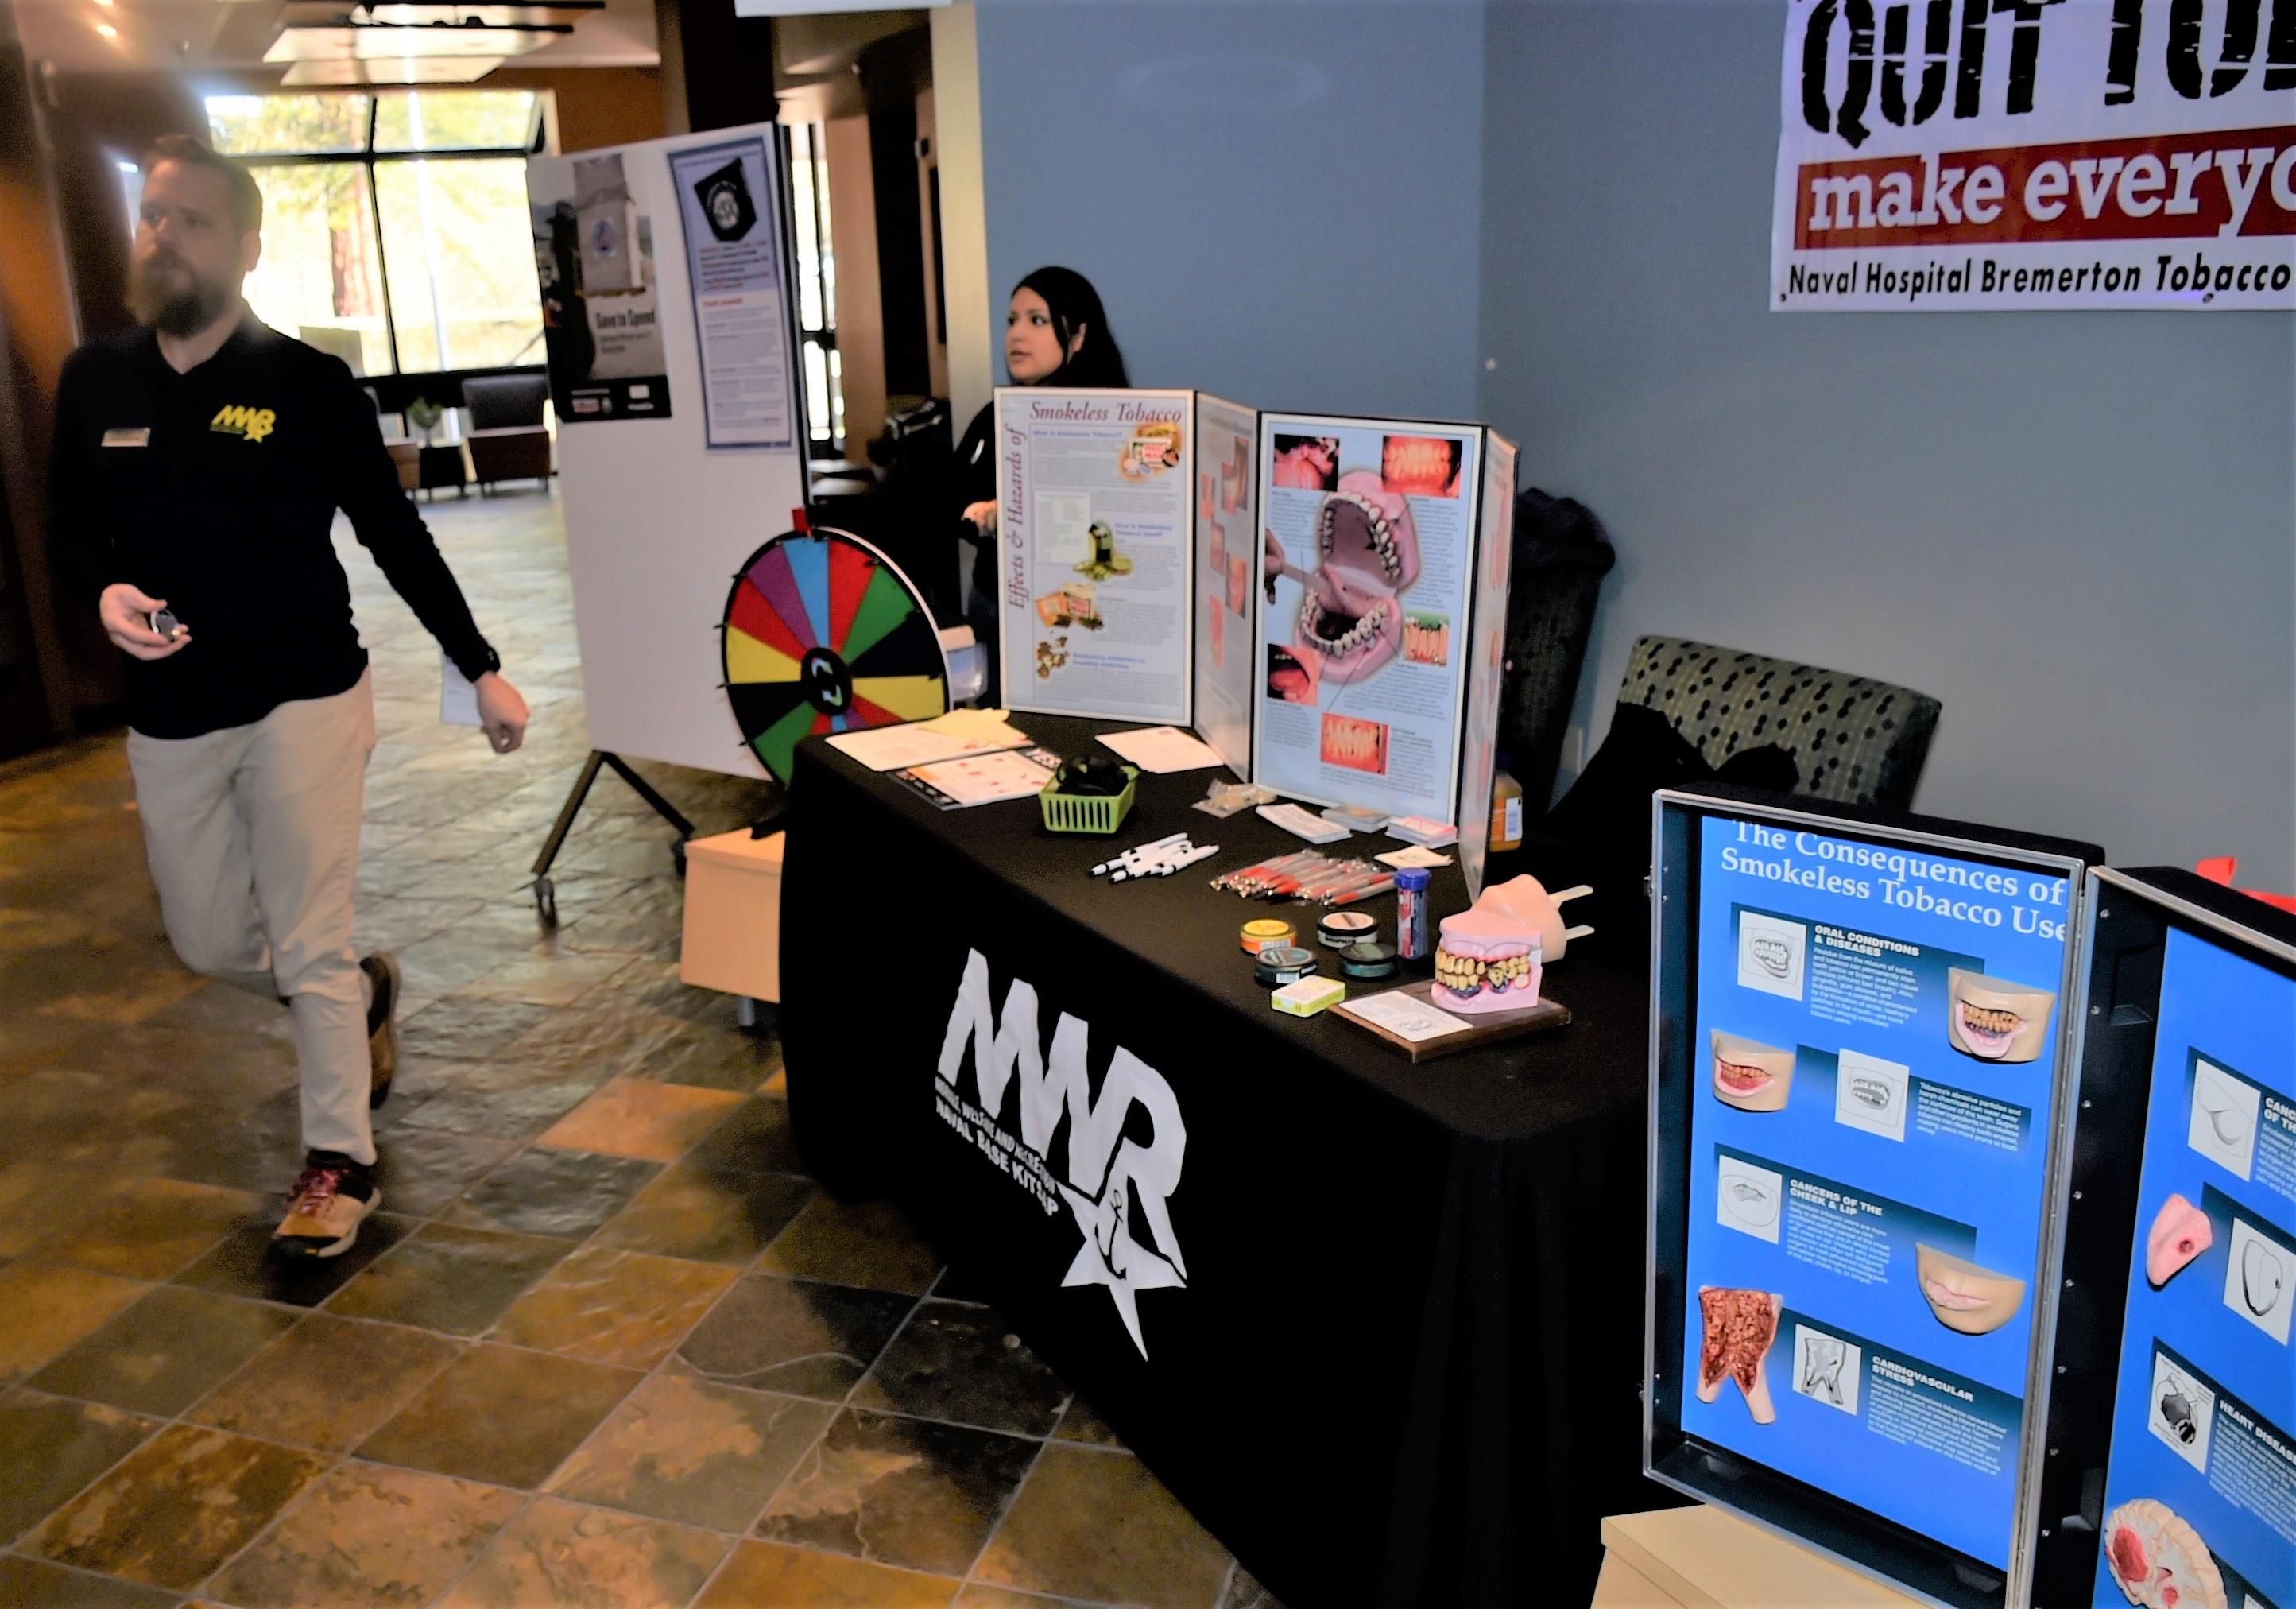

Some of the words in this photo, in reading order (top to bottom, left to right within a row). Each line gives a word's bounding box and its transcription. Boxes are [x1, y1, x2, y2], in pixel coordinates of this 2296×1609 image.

[1802, 0, 2065, 149] QUIT
[1809, 154, 2005, 231] make
[1789, 262, 1856, 294] Naval
[1866, 258, 1972, 301] Hospital
[1981, 260, 2141, 293] Bremerton
[2155, 252, 2292, 293] Tobacco
[1029, 401, 1109, 421] Smokeless
[1117, 401, 1181, 422] Tobacco
[1005, 423, 1027, 445] of
[1005, 452, 1023, 525] Hazards
[1008, 557, 1029, 609] Effects
[1732, 820, 1786, 850] The
[1795, 832, 2018, 897] Consequences
[2028, 878, 2066, 905] of
[1721, 847, 1870, 899] Smokeless
[1878, 878, 2002, 927] Tobacco
[2011, 905, 2066, 941] Use
[1814, 925, 1845, 939] ORAL
[1847, 932, 1919, 956] CONDITIONS
[1814, 934, 1823, 944] &
[1826, 936, 1881, 957] DISEASES
[937, 948, 1187, 1279] MWR
[2264, 1108, 2278, 1123] OF
[2265, 1097, 2296, 1119] CANC
[936, 1095, 974, 1143] NAVAL
[977, 1129, 1010, 1173] BASE
[1790, 1178, 1841, 1202] CANCERS
[1842, 1196, 1857, 1207] OF
[1860, 1201, 1883, 1216] THE
[1790, 1187, 1826, 1207] CHEEK
[1840, 1204, 1857, 1215] LIP
[1872, 1364, 1915, 1387] STRESS
[1872, 1356, 1974, 1402] CARDIOVASCULAR
[2220, 1400, 2255, 1431] HEART
